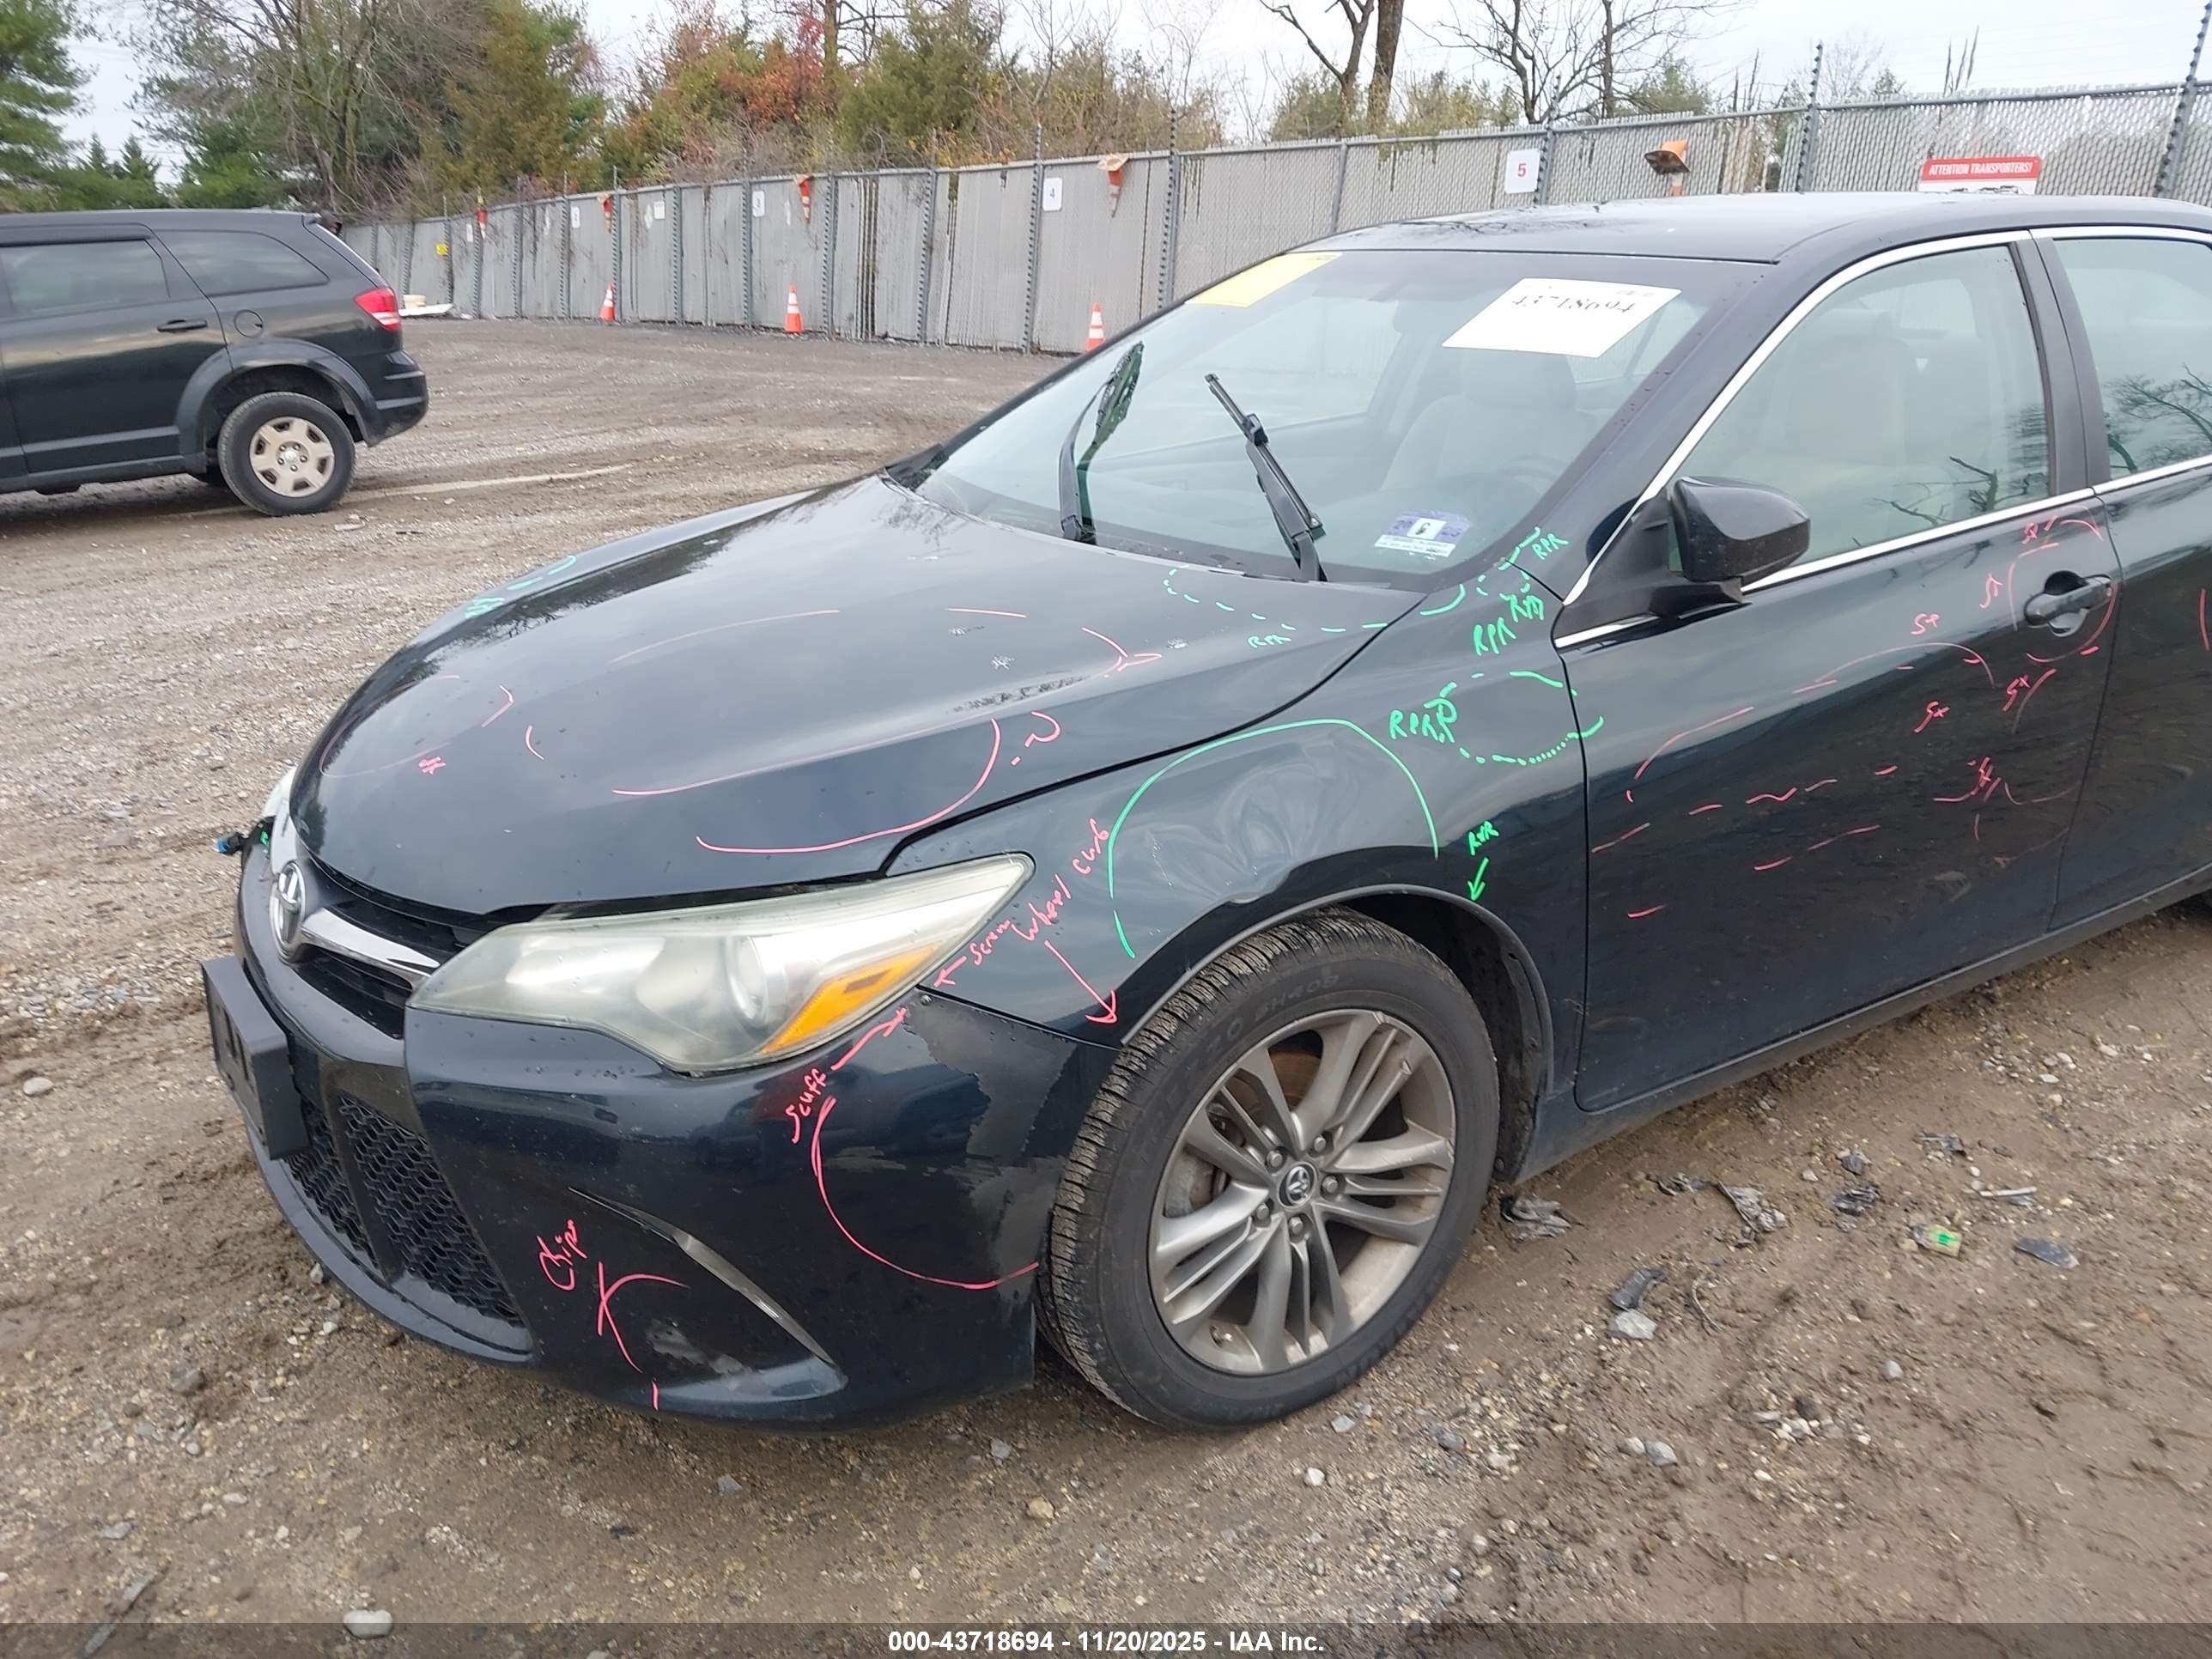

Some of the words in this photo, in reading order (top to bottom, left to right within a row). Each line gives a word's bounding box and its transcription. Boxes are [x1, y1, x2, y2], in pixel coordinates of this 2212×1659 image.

[1517, 162, 1527, 177] 5
[1929, 163, 1969, 176] ATTENTION
[1970, 161, 2033, 174] TRANSPORTERS!
